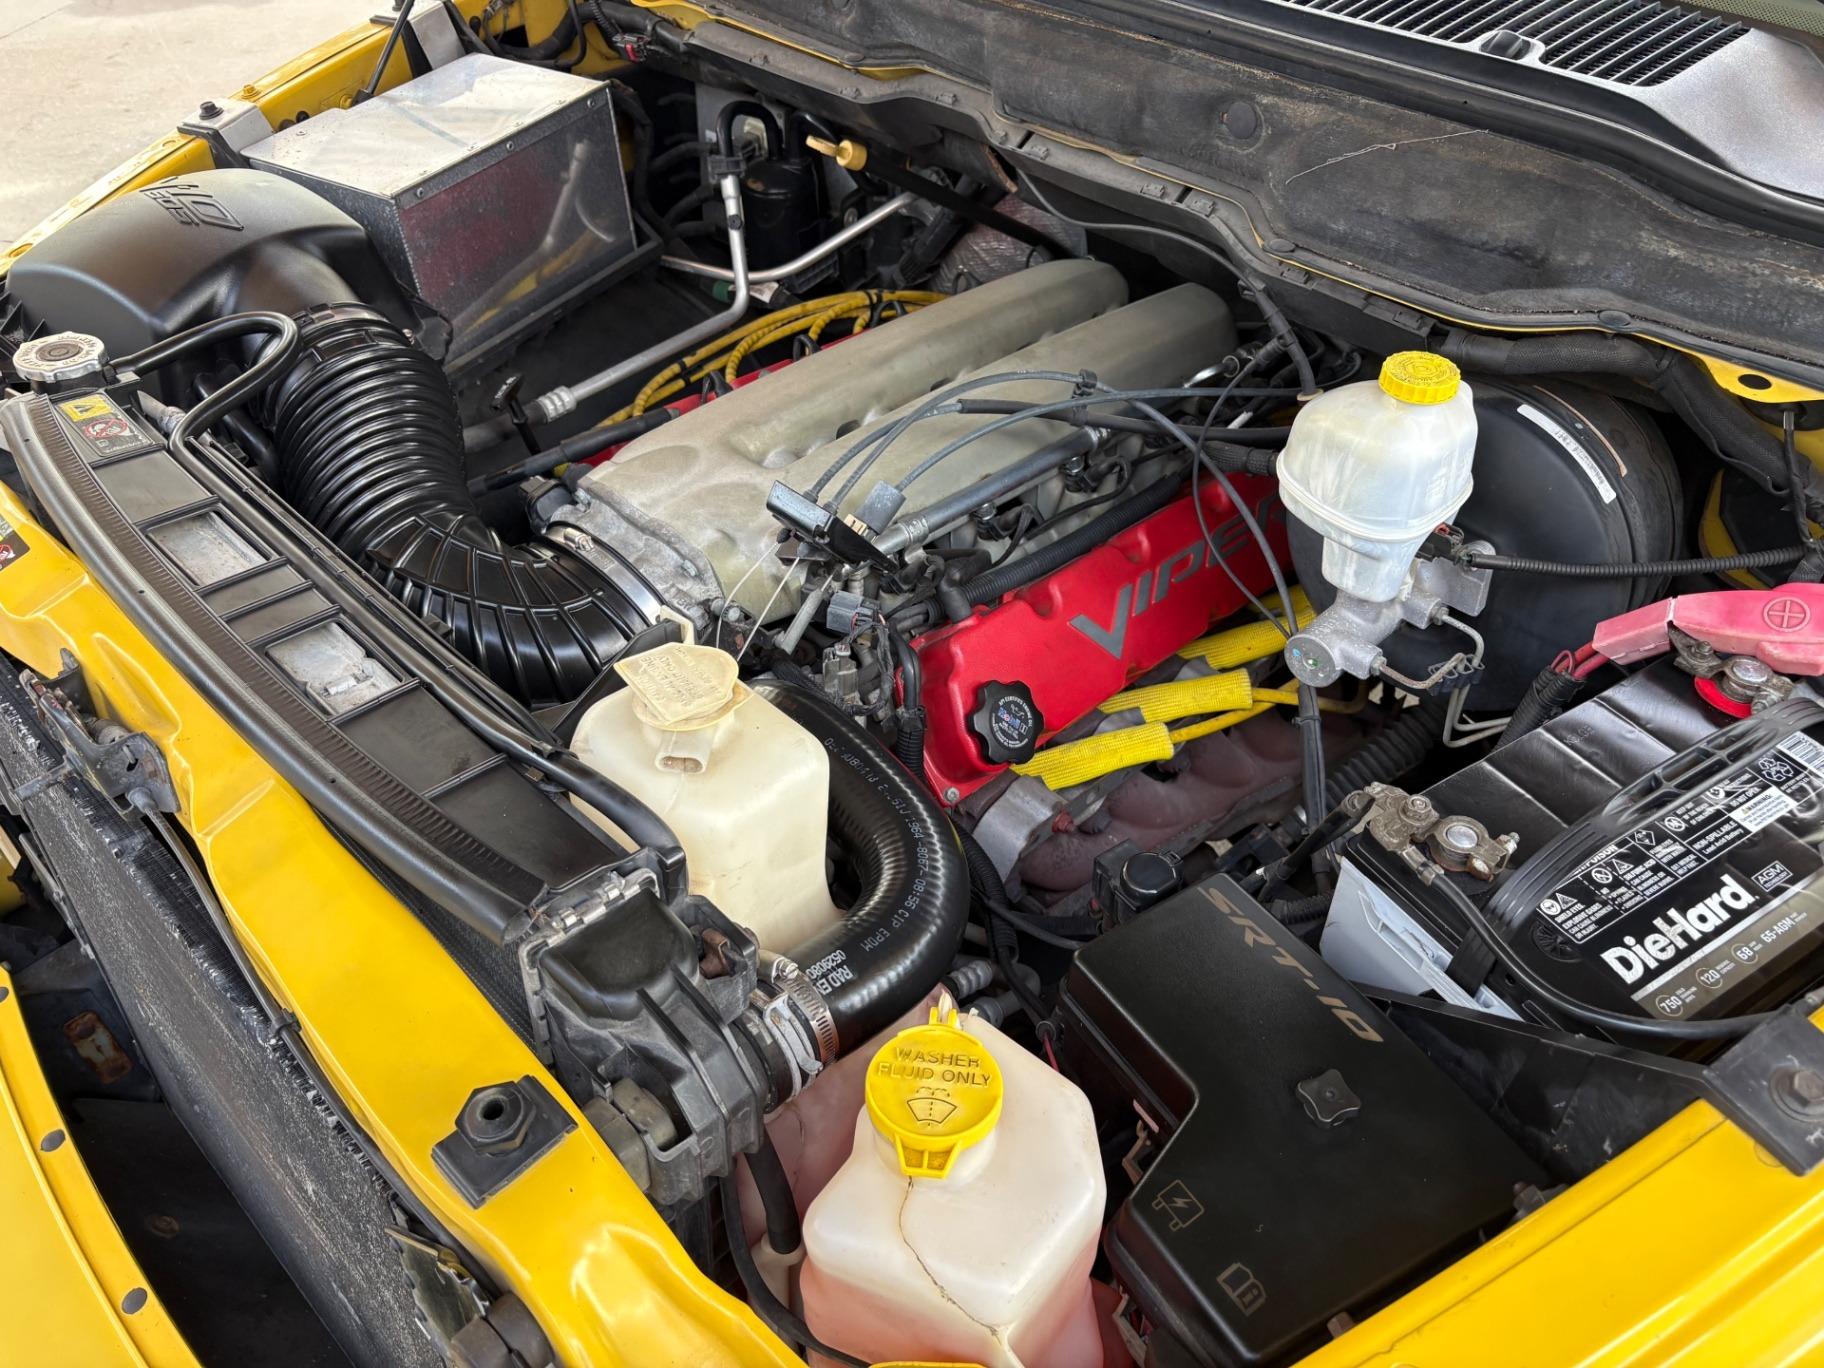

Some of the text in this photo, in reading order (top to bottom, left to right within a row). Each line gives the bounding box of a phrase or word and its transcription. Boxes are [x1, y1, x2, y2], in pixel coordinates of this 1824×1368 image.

[1692, 820, 1737, 849] NON-SPILLABLE
[1757, 863, 1783, 883] AGM
[904, 879, 926, 909] 08:56
[1601, 874, 1756, 984] DieHard
[1735, 945, 1754, 959] 68
[1197, 887, 1385, 1042] SRT-10
[829, 965, 853, 987] RAD
[1700, 968, 1720, 984] 120
[1659, 994, 1682, 1012] 750
[896, 1047, 980, 1069] WASHER
[878, 1062, 992, 1087] FLUID ONLY
